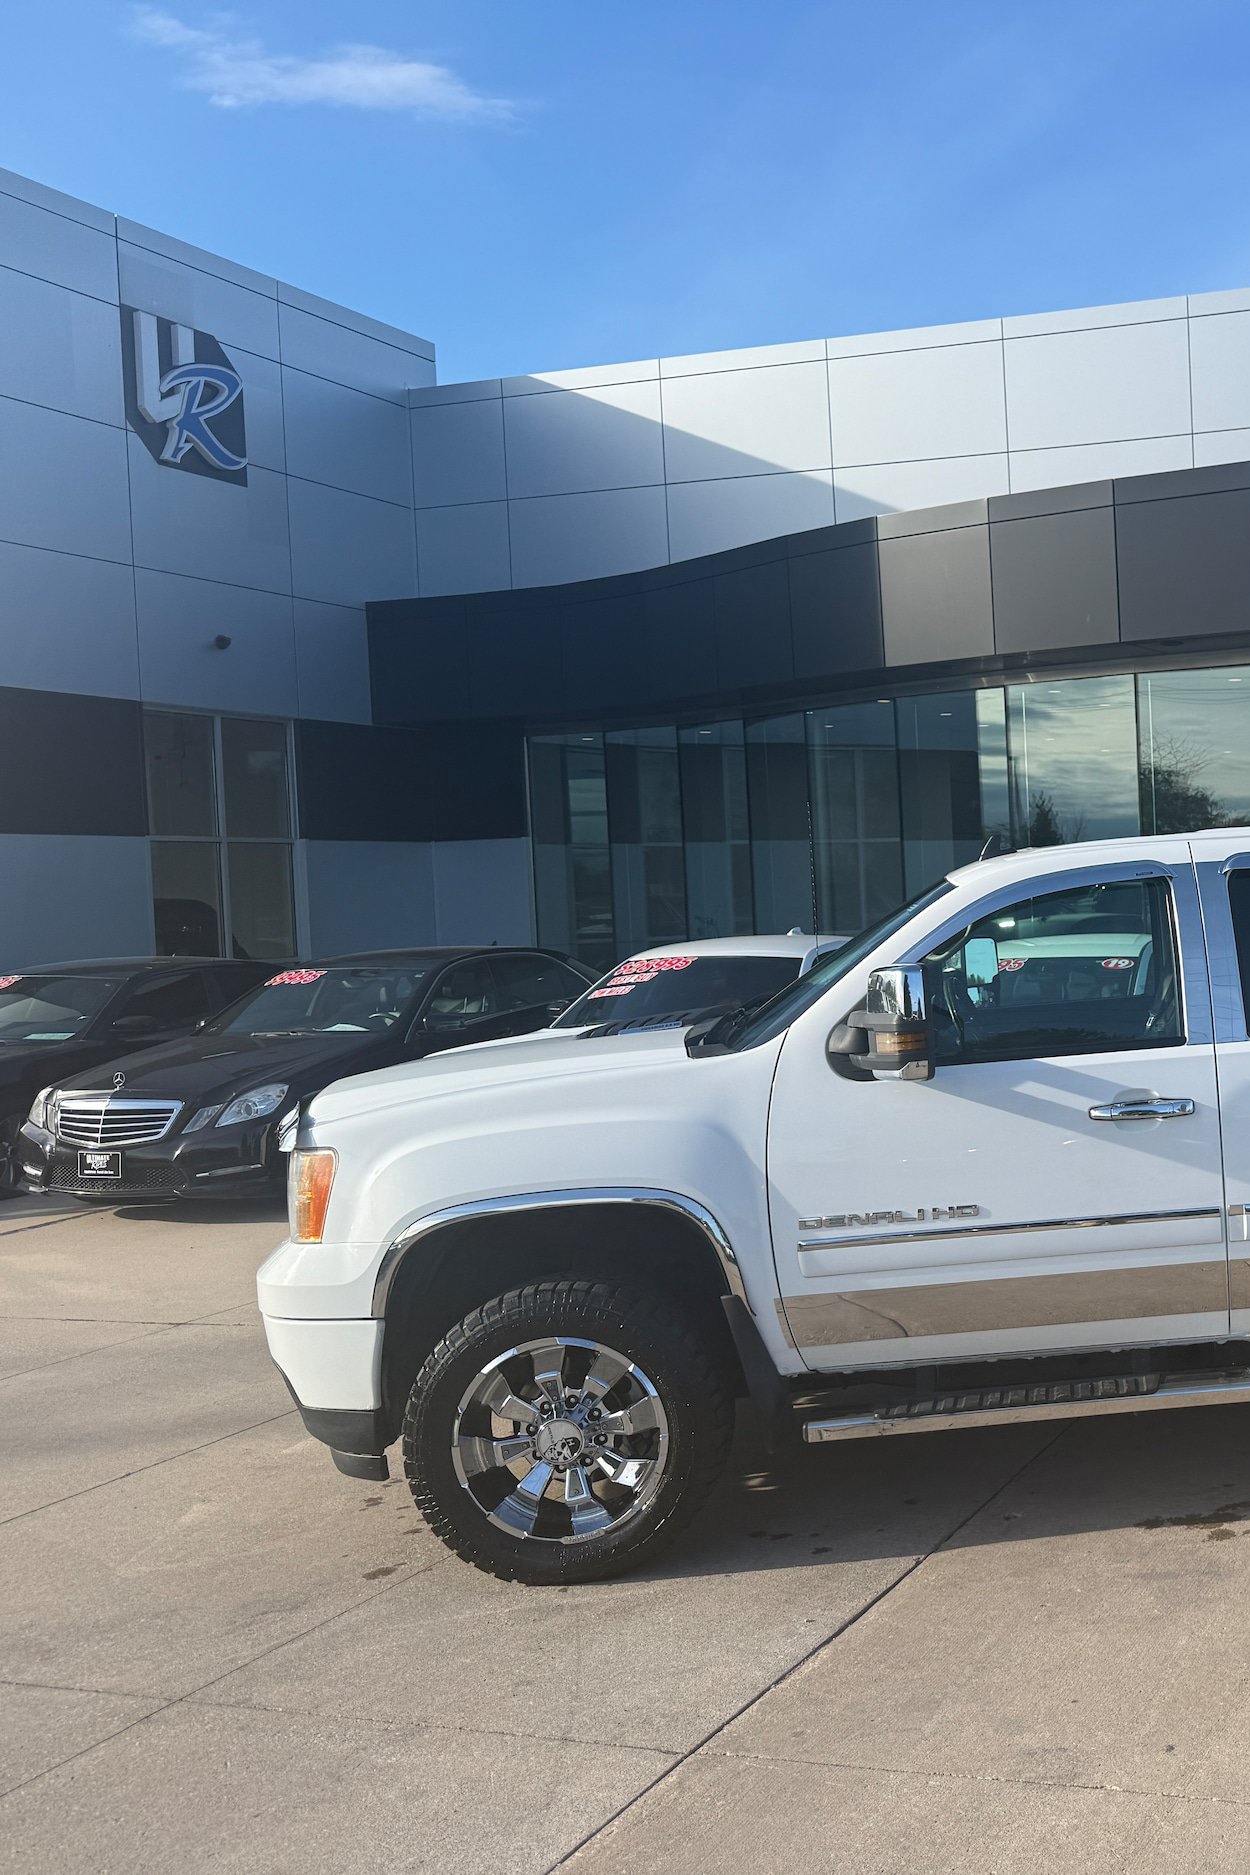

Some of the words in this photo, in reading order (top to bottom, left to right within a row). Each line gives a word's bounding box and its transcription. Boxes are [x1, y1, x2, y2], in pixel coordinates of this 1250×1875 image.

[1108, 958, 1130, 969] 19
[798, 1208, 925, 1231] DENALI
[932, 1204, 980, 1221] HD
